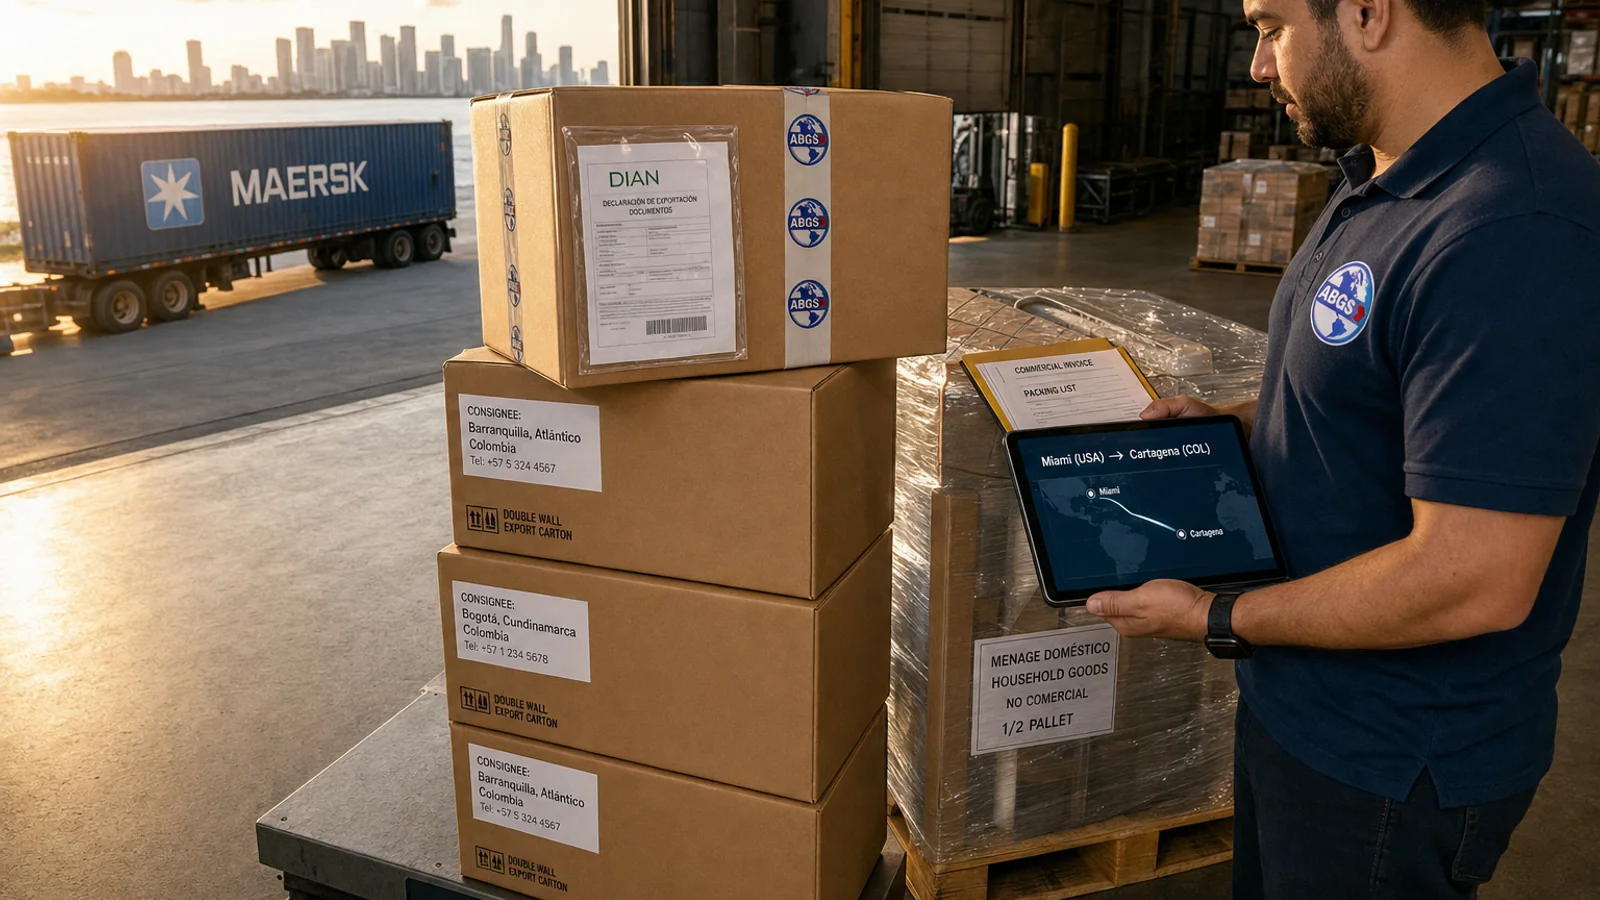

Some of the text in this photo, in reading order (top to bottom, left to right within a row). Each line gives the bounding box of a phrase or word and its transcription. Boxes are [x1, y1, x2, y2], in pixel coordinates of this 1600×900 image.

[790, 133, 819, 145] ABGS
[230, 160, 370, 207] MAERSK
[609, 170, 659, 187] DIAN
[603, 198, 645, 207] DECLARACIÓN
[657, 195, 698, 204] EXPORTACIÓN
[629, 207, 672, 216] DOCUMENTOS
[790, 217, 819, 228] ABGS
[790, 298, 820, 310] ABGS
[1318, 285, 1355, 315] ABGS
[1015, 362, 1062, 374] COMMERCIAL
[1024, 387, 1058, 397] PACKING
[468, 406, 521, 420] CONSIGNEE:
[468, 422, 581, 443] Barranquilla, Atlántico
[469, 439, 516, 453] Colombia
[1041, 442, 1211, 468] Miami (USA) Cartagena (COL)
[470, 455, 556, 473] Tel: +57 5 324 4567
[1099, 486, 1120, 496] Miami
[503, 509, 562, 526] DOUBLE WALL
[504, 522, 572, 540] EXPORT CARTON
[1190, 528, 1223, 539] Cartagena
[461, 592, 515, 610] CONSIGNEE:
[462, 608, 576, 637] Bogotá, Cundinamarca
[463, 624, 509, 642] Colombia
[464, 640, 548, 664] Tel: +57 1 234 5678
[991, 641, 1111, 668] MENAGE DOMÉSTICO
[992, 663, 1109, 689] HOUSEHOLD GOODS
[494, 694, 548, 714] DOUBLE WALL
[1006, 688, 1088, 709] NO COMERCIAL
[495, 706, 558, 728] EXPORT CARTON
[1002, 713, 1074, 737] 1/2 PALLET
[477, 755, 530, 777] CONSIGNEE:
[478, 771, 585, 808] Barranquilla, Atlántico
[479, 786, 524, 807] Colombia
[480, 802, 494, 813] Tel:
[521, 813, 537, 825] 324
[508, 855, 556, 877] DOUBLE WALL
[509, 867, 568, 892] EXPORT CARTON
